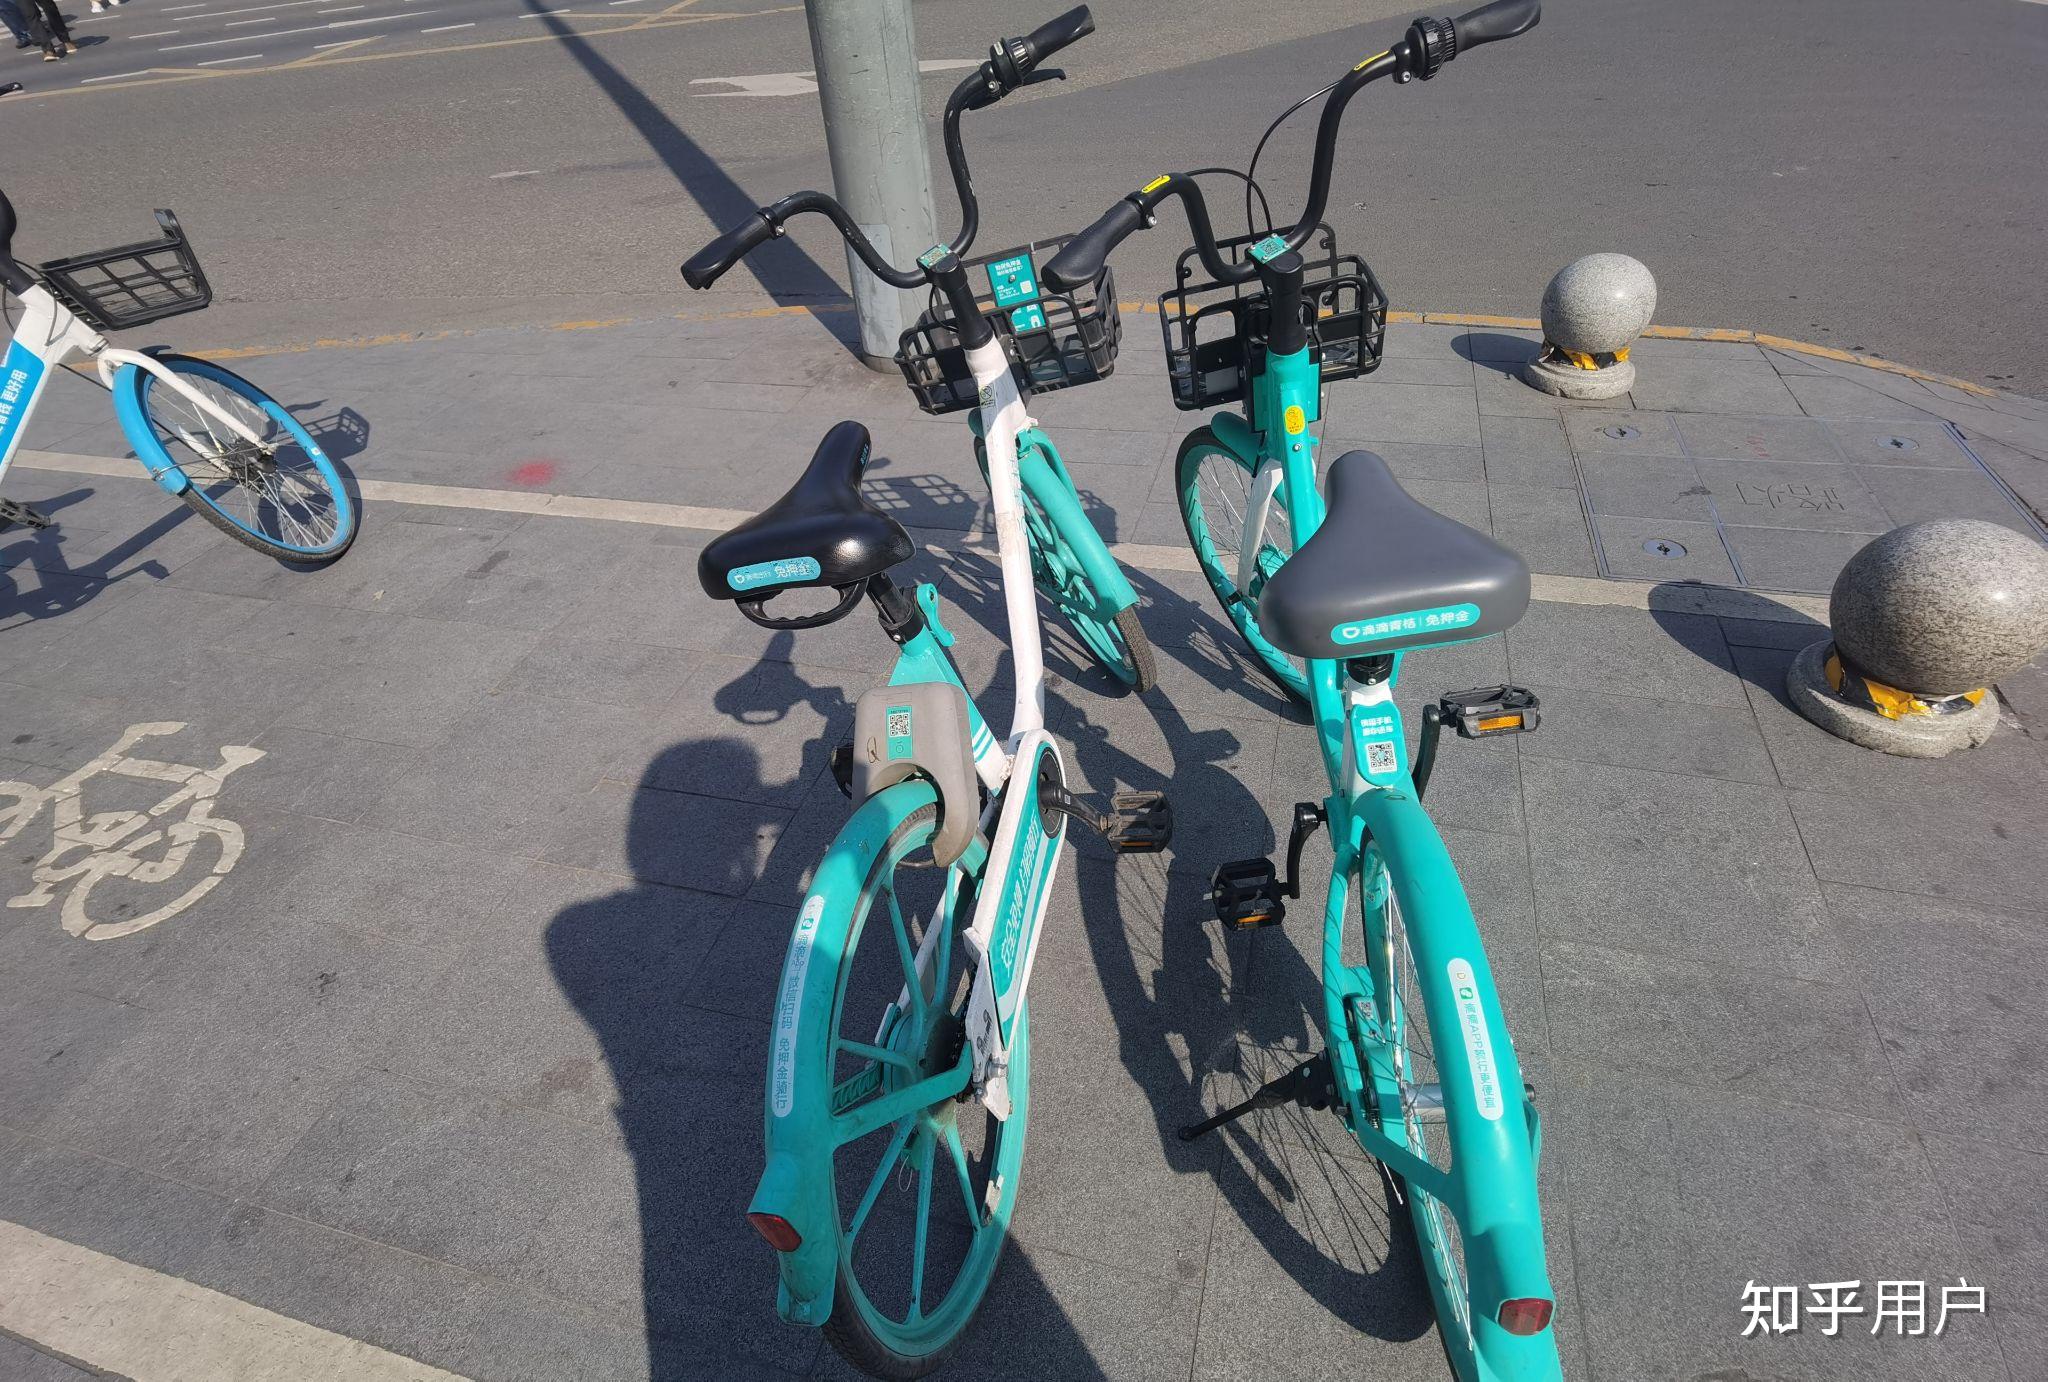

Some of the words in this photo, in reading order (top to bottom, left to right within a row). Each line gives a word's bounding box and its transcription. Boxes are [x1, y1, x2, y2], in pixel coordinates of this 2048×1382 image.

[1, 369, 28, 403] 更好用
[1362, 617, 1416, 637] 滴滴青桔
[1425, 610, 1471, 627] 免押金
[781, 974, 799, 1030] 微信扫码
[774, 1037, 790, 1110] 免押金骑行
